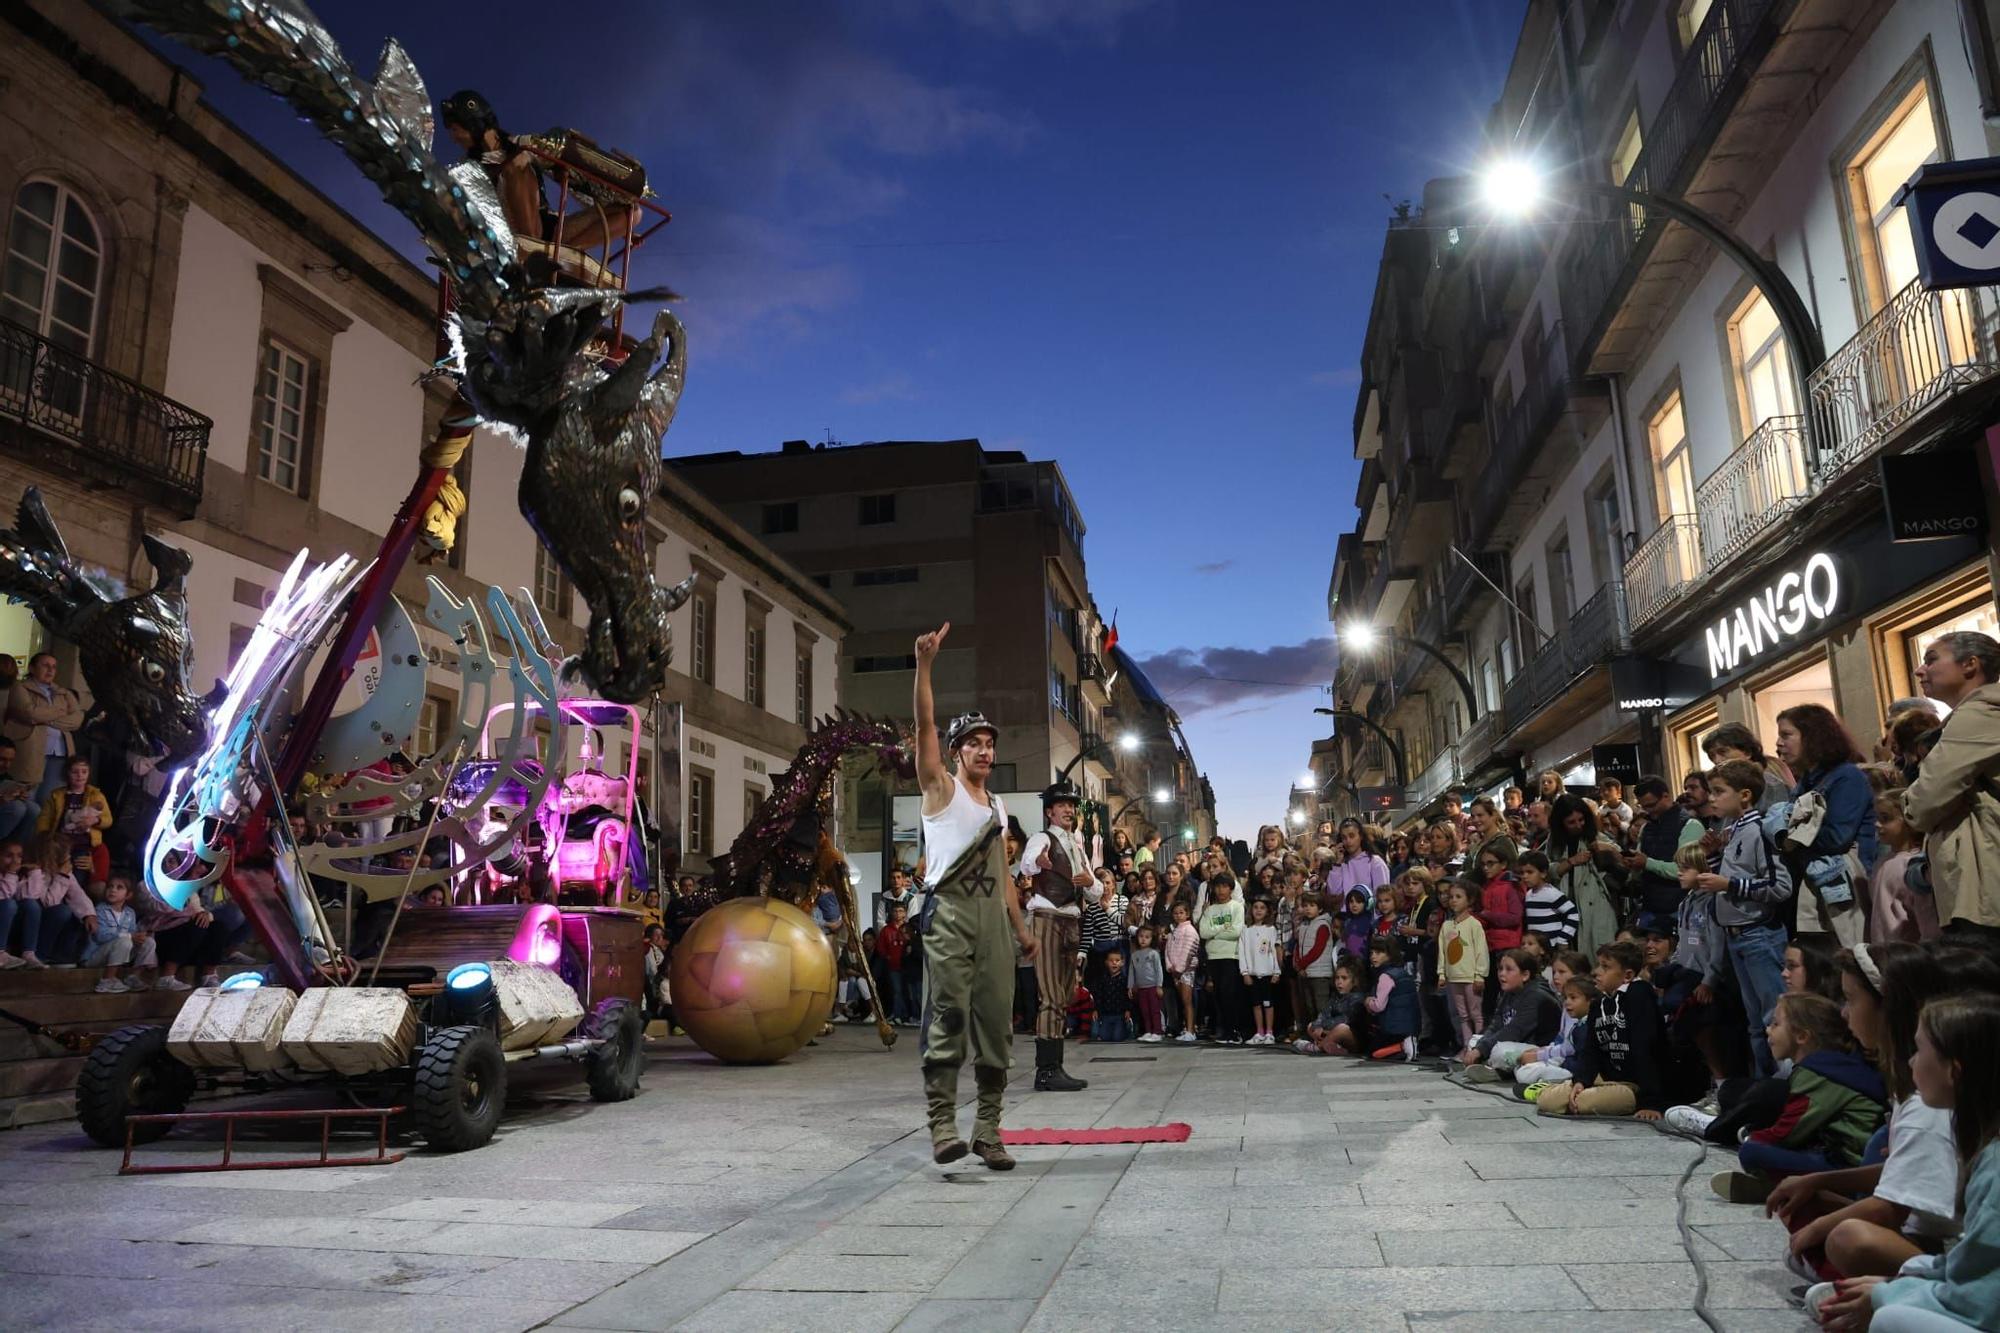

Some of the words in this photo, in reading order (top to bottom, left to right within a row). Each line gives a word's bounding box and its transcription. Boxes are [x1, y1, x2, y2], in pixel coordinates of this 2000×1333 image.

[1904, 517, 1978, 533] MANGO
[1706, 553, 1838, 679] MANGO
[1620, 698, 1663, 709] MANGO
